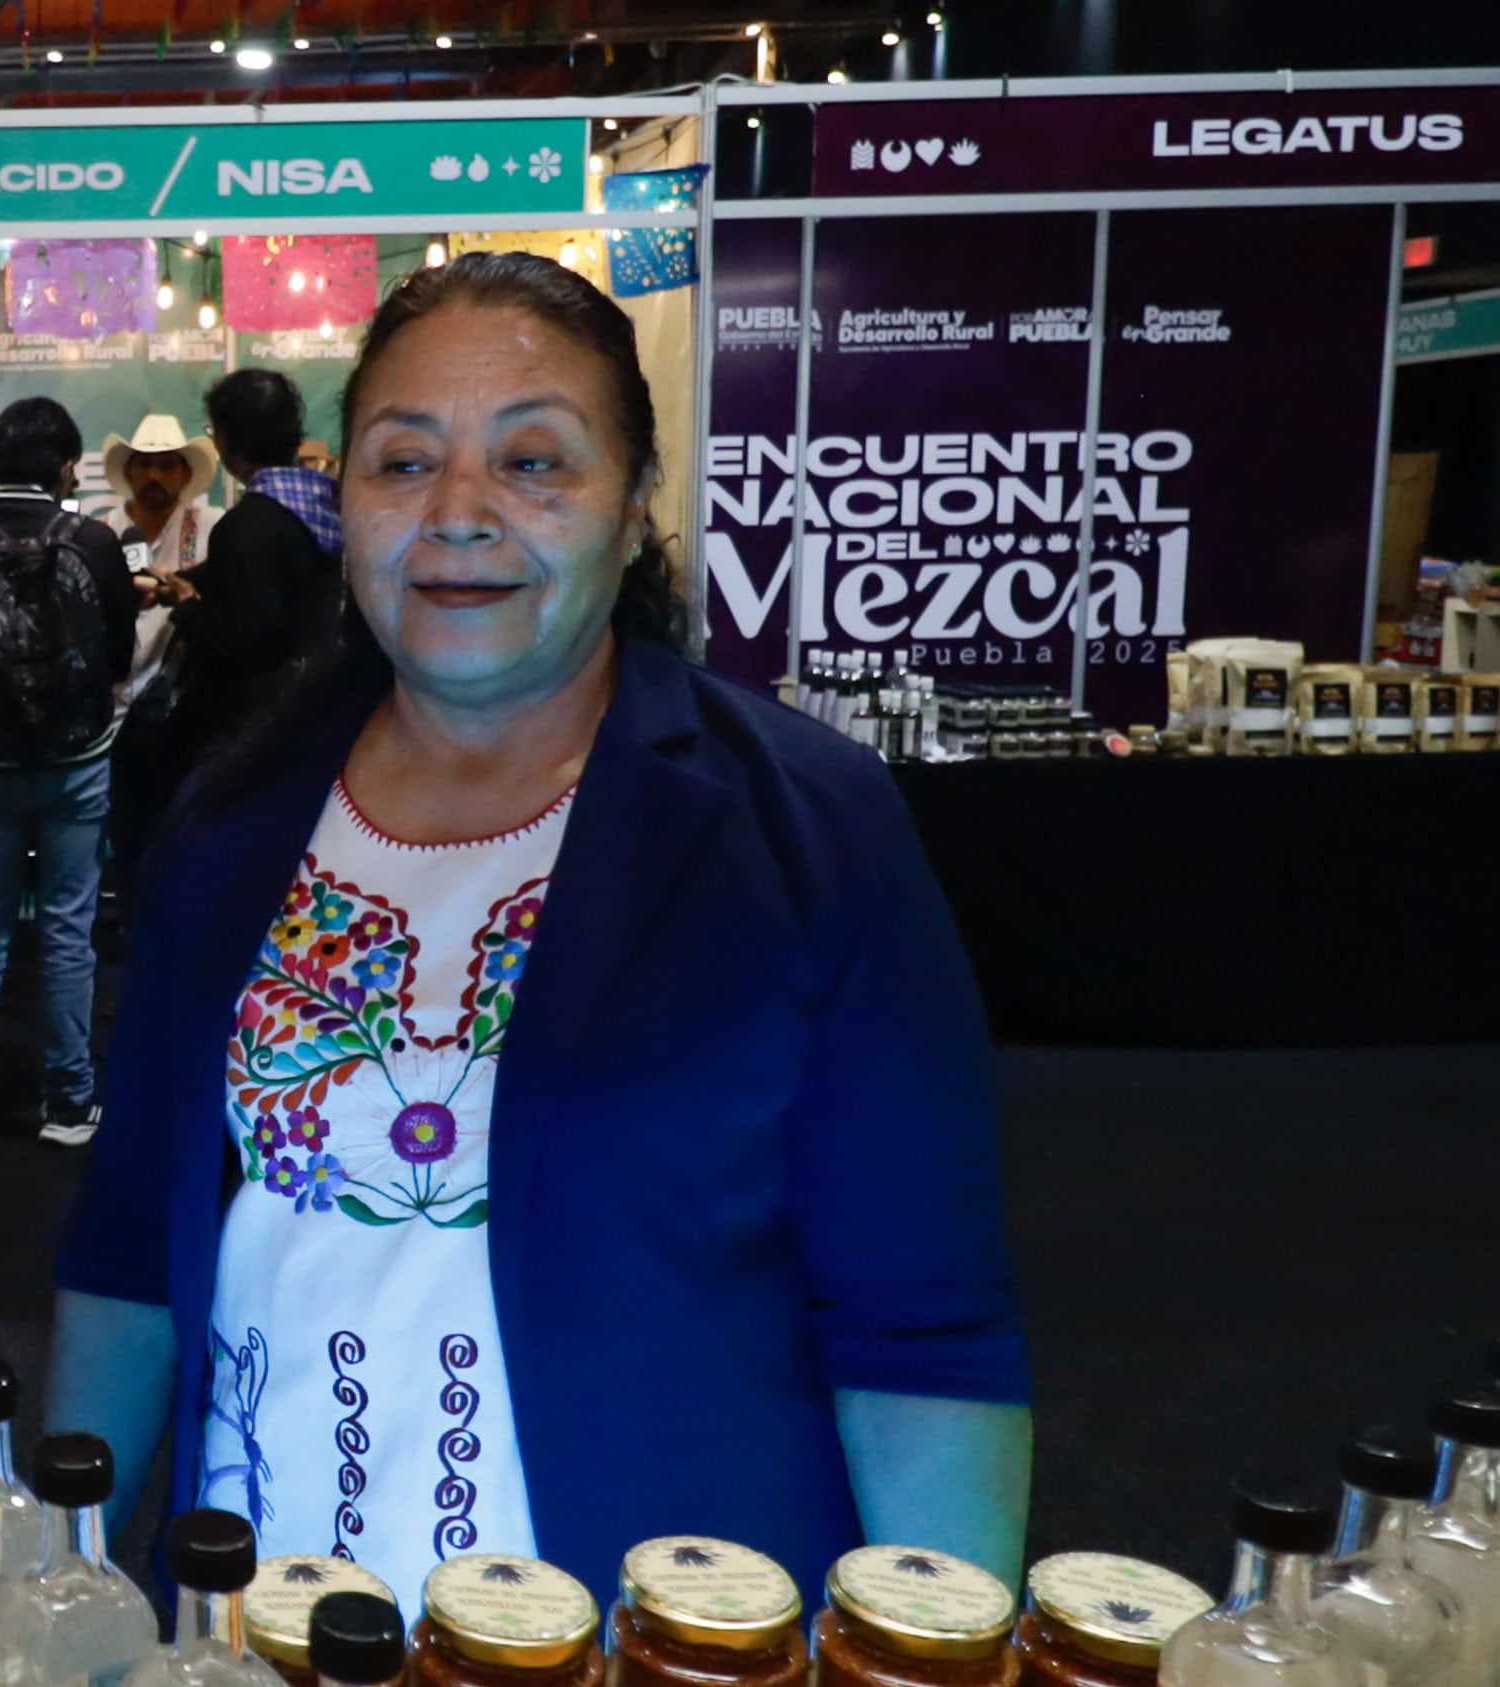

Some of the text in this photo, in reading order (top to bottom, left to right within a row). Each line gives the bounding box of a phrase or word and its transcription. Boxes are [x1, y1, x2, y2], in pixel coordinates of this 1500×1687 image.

[1153, 114, 1464, 156] LEGATUS
[217, 158, 374, 195] NISA
[840, 309, 966, 331] Agricultura y
[1144, 305, 1222, 325] Pensar
[839, 325, 939, 343] Desarrollo
[942, 323, 994, 341] Rural
[1147, 324, 1231, 343] Grande
[707, 430, 1193, 477] ENCUENTRO
[706, 475, 1190, 528] NACIONAL
[837, 532, 938, 561] DEL
[704, 526, 1190, 643] Mezcal
[911, 642, 1054, 665] Puebla
